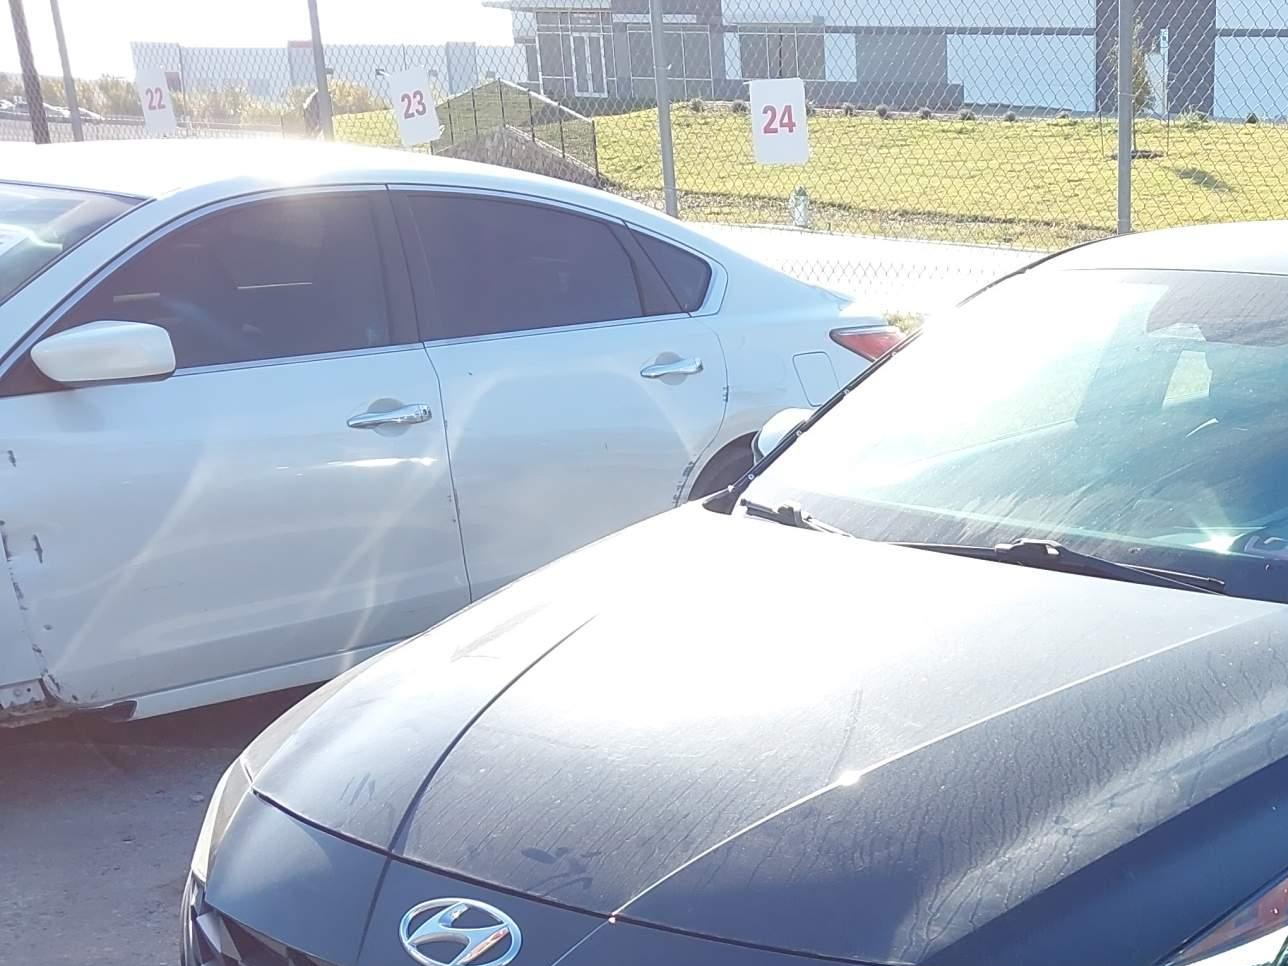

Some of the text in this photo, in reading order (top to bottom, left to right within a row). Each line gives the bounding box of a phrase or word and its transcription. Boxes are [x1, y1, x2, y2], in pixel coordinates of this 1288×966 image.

[145, 87, 166, 110] 22
[401, 90, 426, 119] 23
[762, 105, 796, 134] 24
